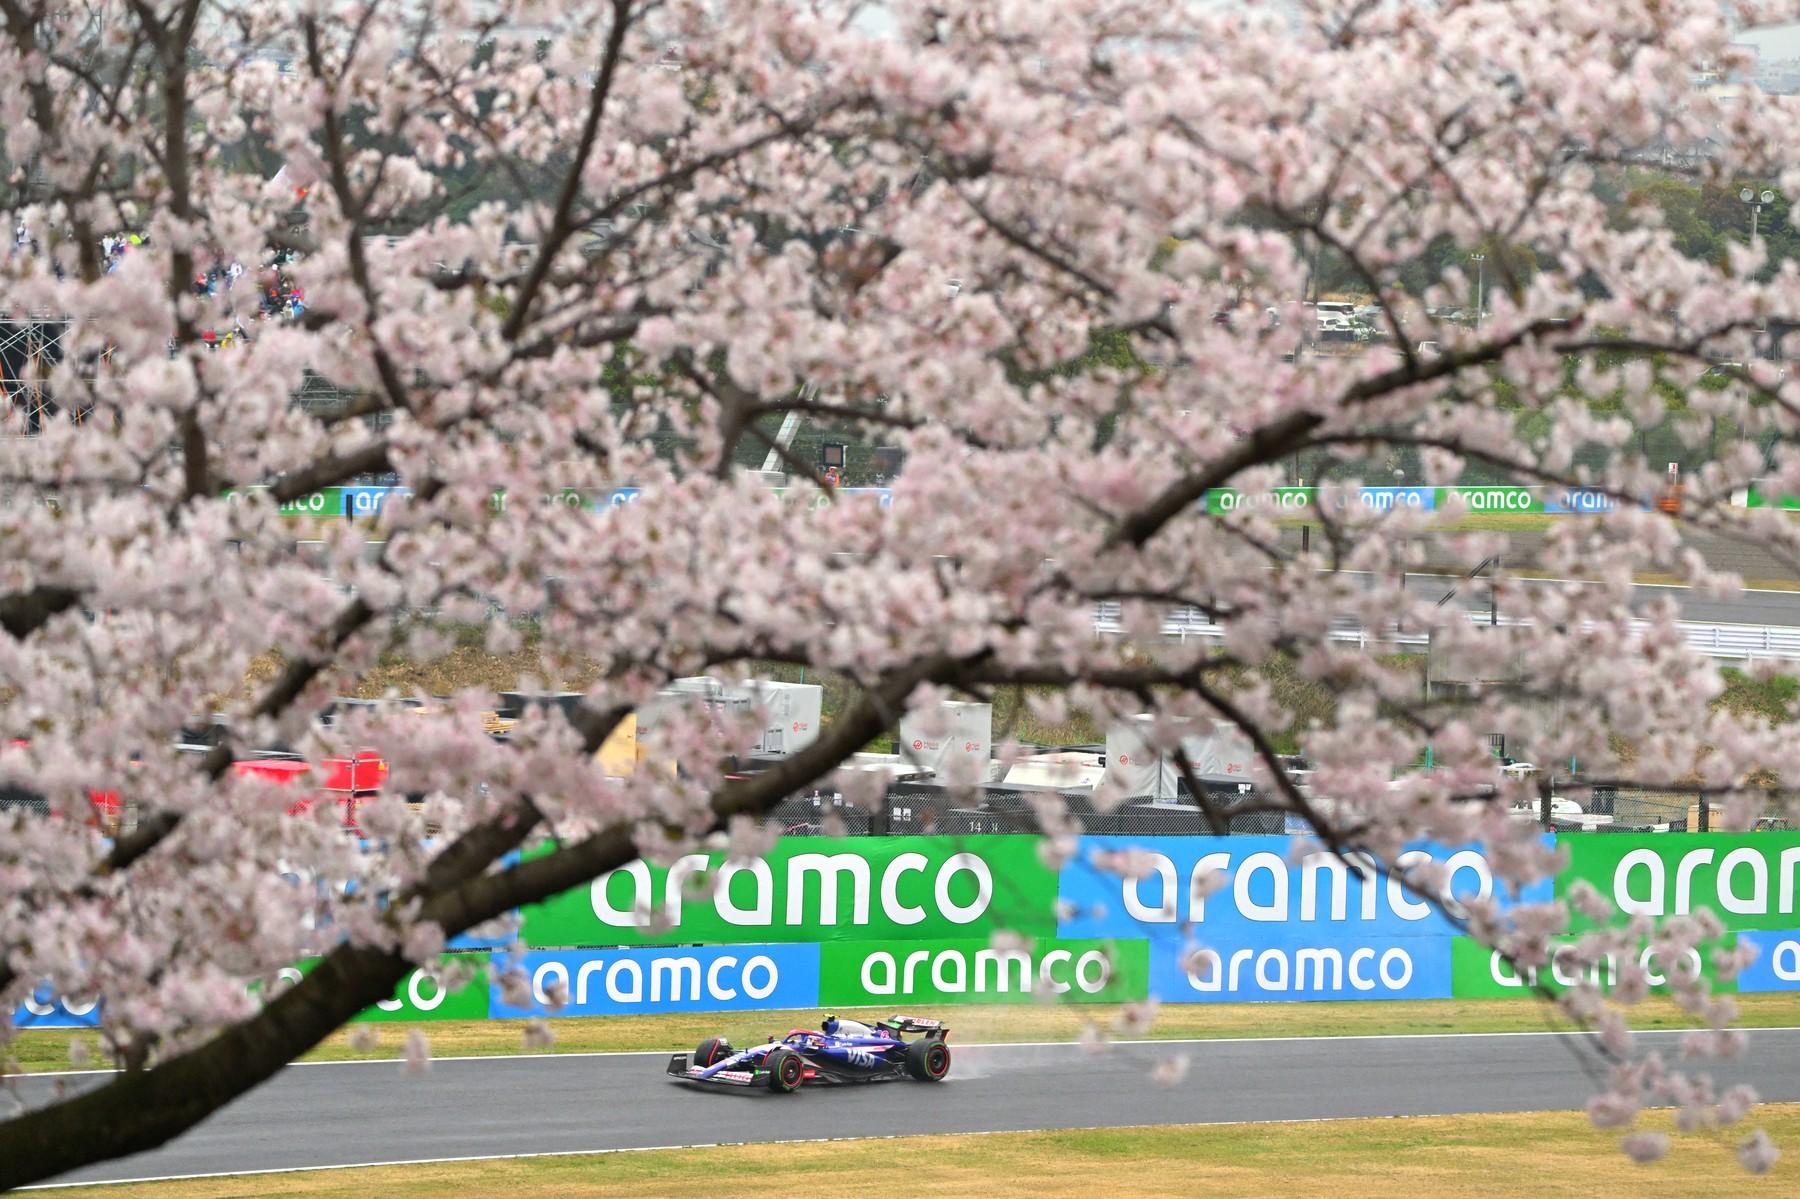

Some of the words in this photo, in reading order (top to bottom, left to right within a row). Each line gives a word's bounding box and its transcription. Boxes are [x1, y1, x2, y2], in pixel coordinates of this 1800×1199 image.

[590, 852, 993, 927] aramco
[1122, 850, 1493, 923] aramco
[1613, 846, 1800, 916] ara
[532, 954, 779, 1006] aramco
[860, 949, 1110, 995] aramco
[1186, 947, 1413, 992] aramco
[847, 1048, 875, 1069] VISA
